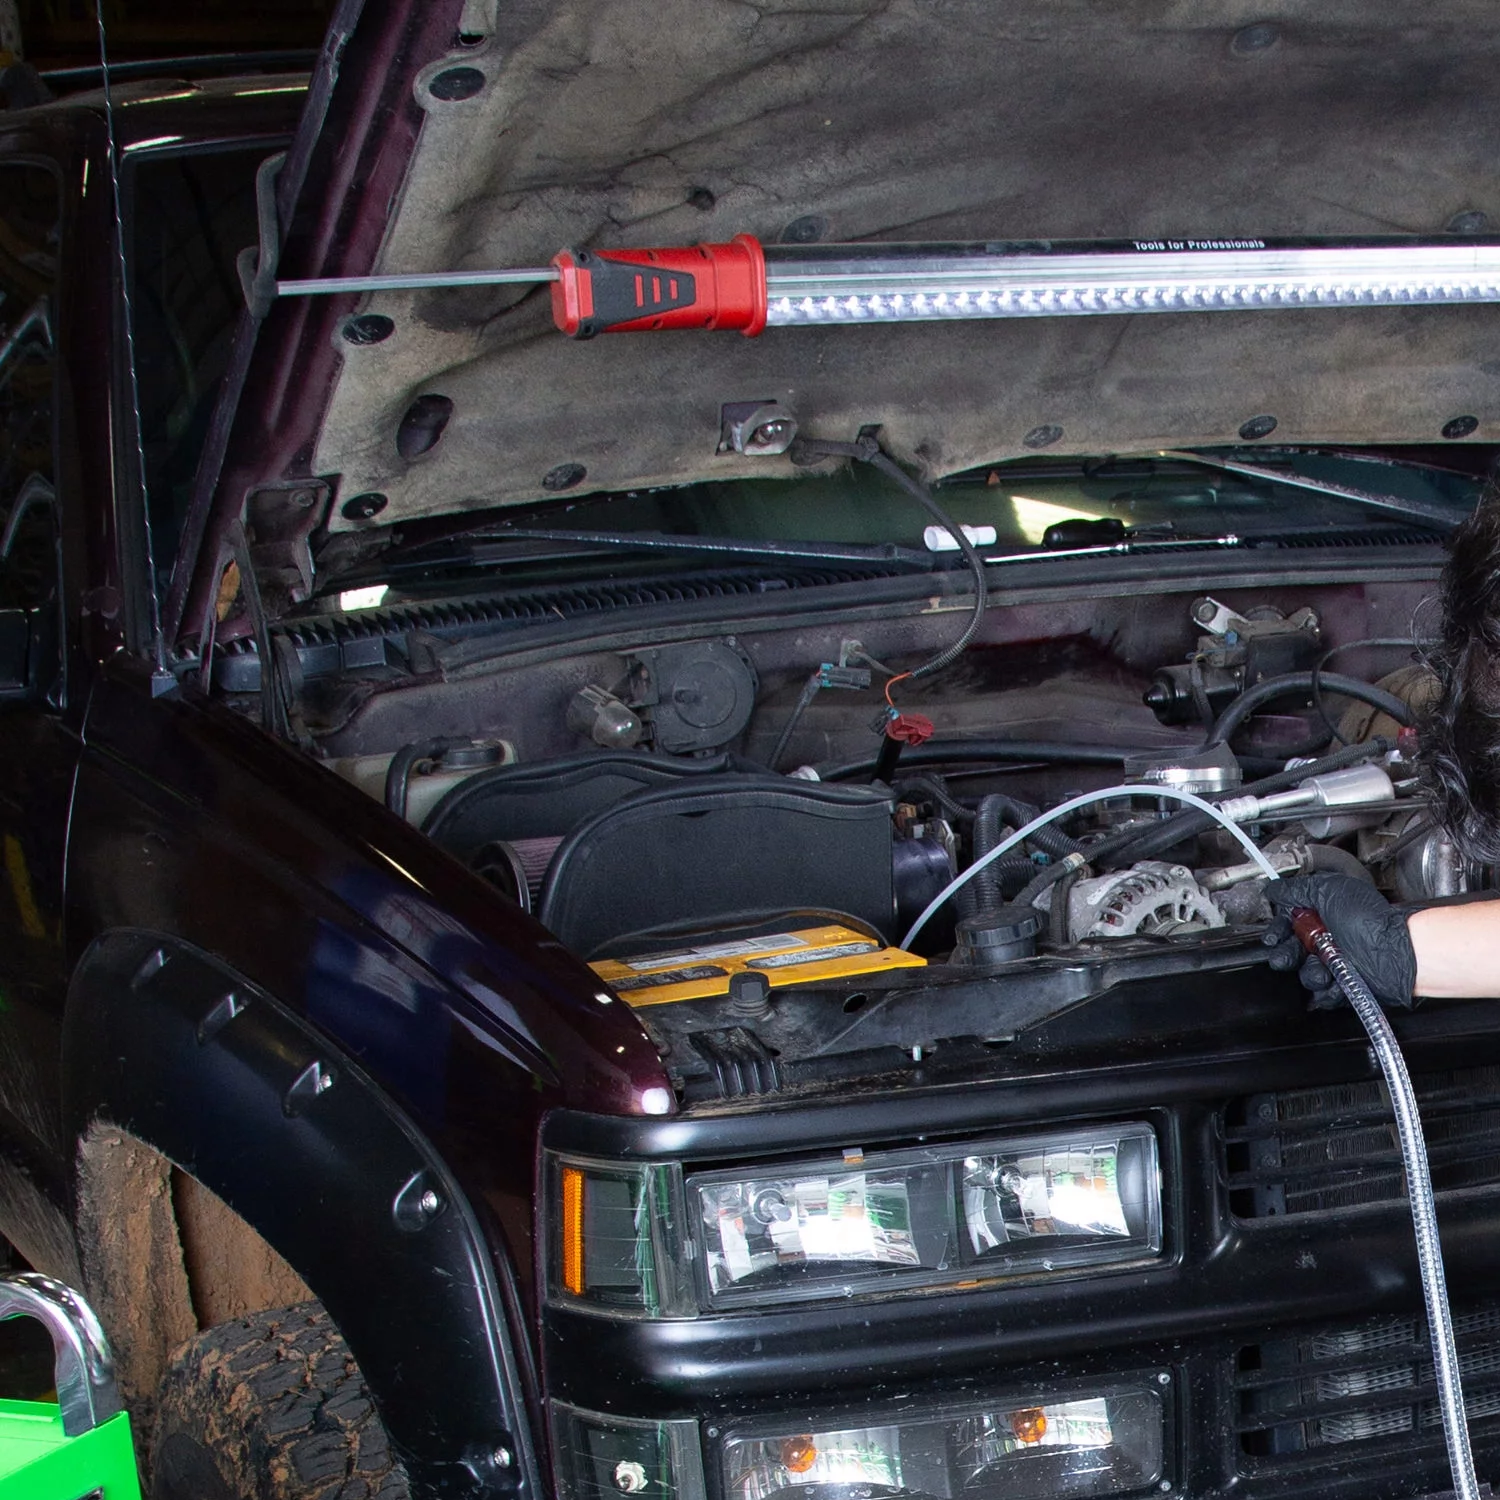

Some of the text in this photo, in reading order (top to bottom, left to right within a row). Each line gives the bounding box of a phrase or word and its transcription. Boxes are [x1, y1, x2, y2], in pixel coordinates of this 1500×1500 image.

[1133, 239, 1266, 251] Tools for Professionals
